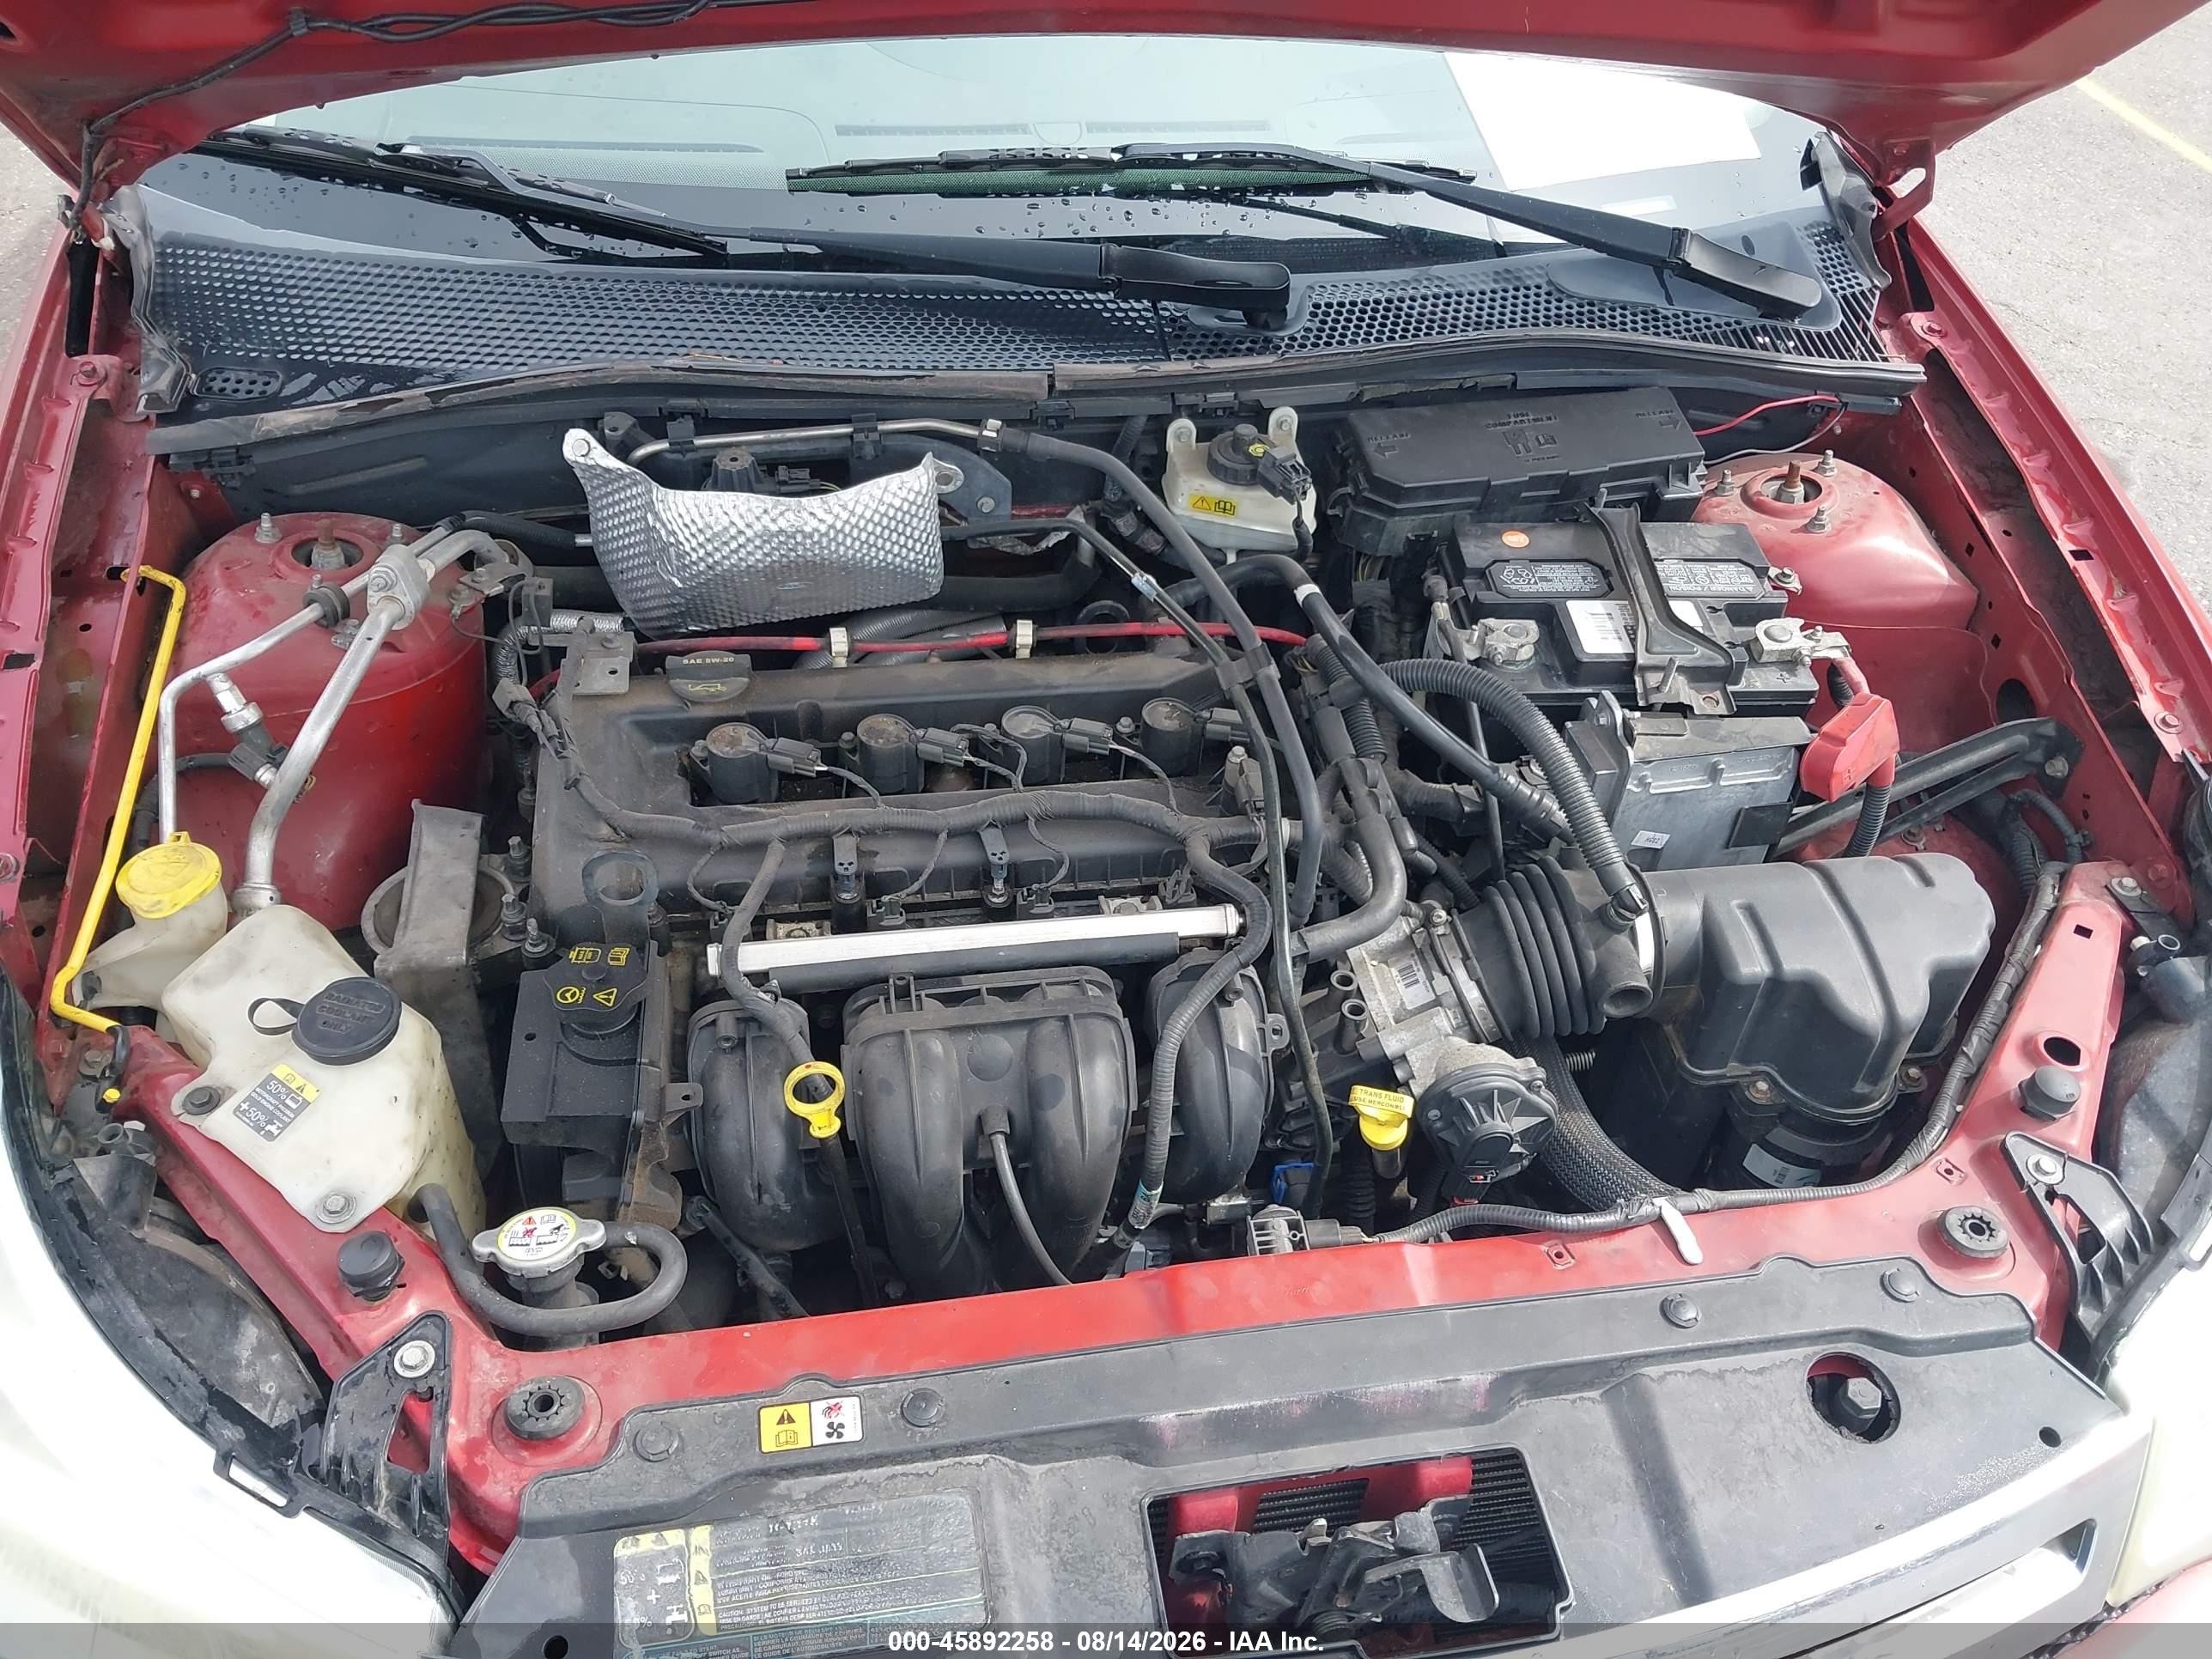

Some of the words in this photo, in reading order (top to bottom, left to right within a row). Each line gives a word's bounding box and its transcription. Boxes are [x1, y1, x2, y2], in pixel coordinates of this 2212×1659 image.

[1485, 414, 1559, 429] COMPARTMENT
[705, 656, 735, 665] 5W-20
[266, 1079, 289, 1099] 50%
[1359, 1088, 1382, 1099] TRANS
[1383, 1093, 1405, 1103] FLUID
[707, 1648, 731, 1657] SWITCH
[763, 1649, 781, 1657] GUIDE
